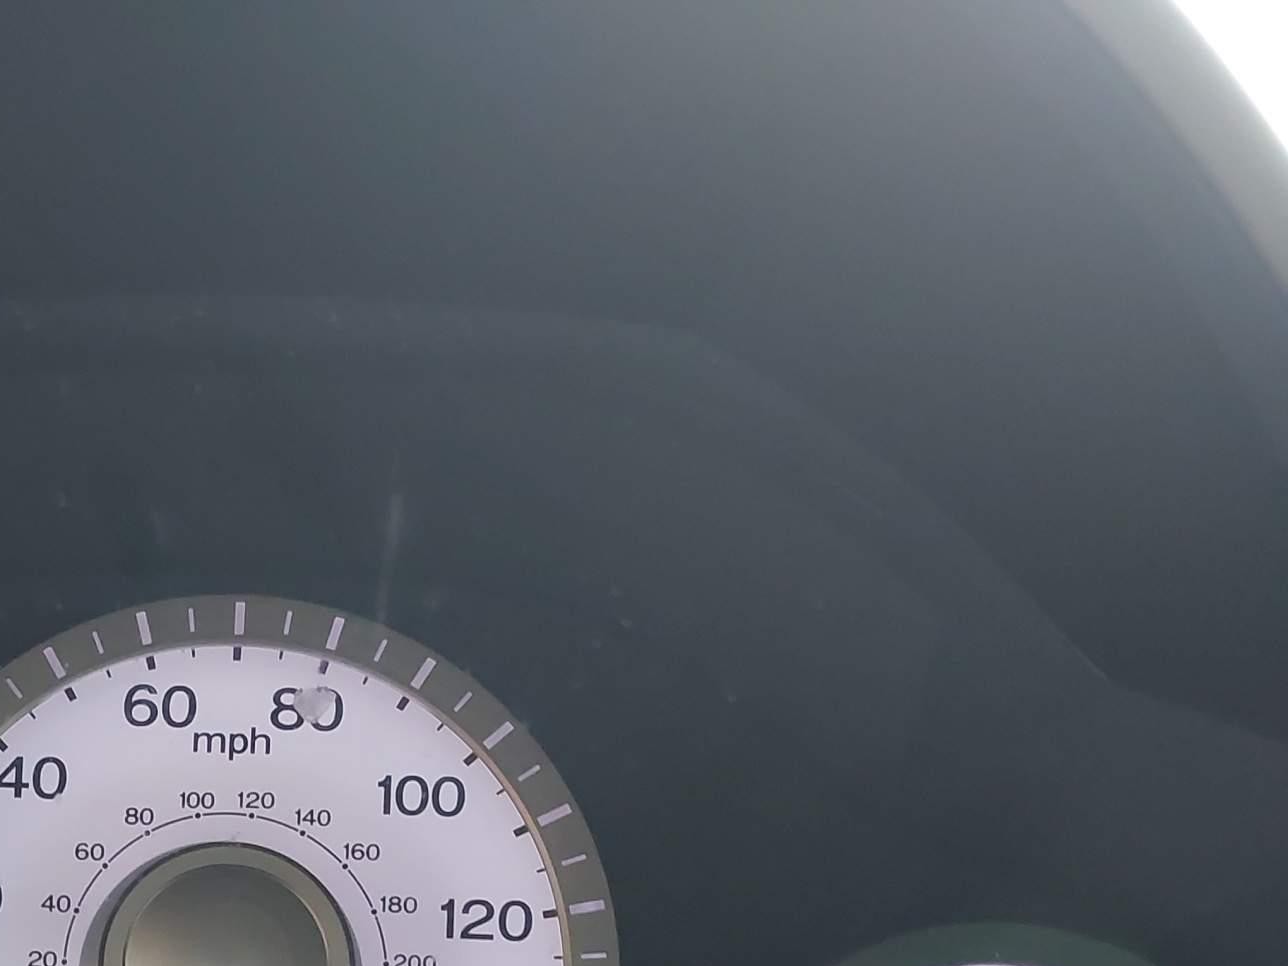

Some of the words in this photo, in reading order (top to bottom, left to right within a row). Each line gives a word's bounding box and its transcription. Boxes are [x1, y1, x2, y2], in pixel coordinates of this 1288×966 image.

[123, 684, 197, 729] 60
[270, 687, 344, 732] 80
[192, 727, 272, 760] mph
[179, 791, 215, 810] 100
[237, 791, 275, 810] 120
[377, 775, 466, 817] 100
[124, 807, 155, 827] 80
[294, 809, 332, 828] 140
[74, 842, 105, 862] 60
[343, 842, 381, 862] 160
[41, 895, 72, 914] 40
[380, 895, 418, 915] 180
[440, 899, 533, 941] 120
